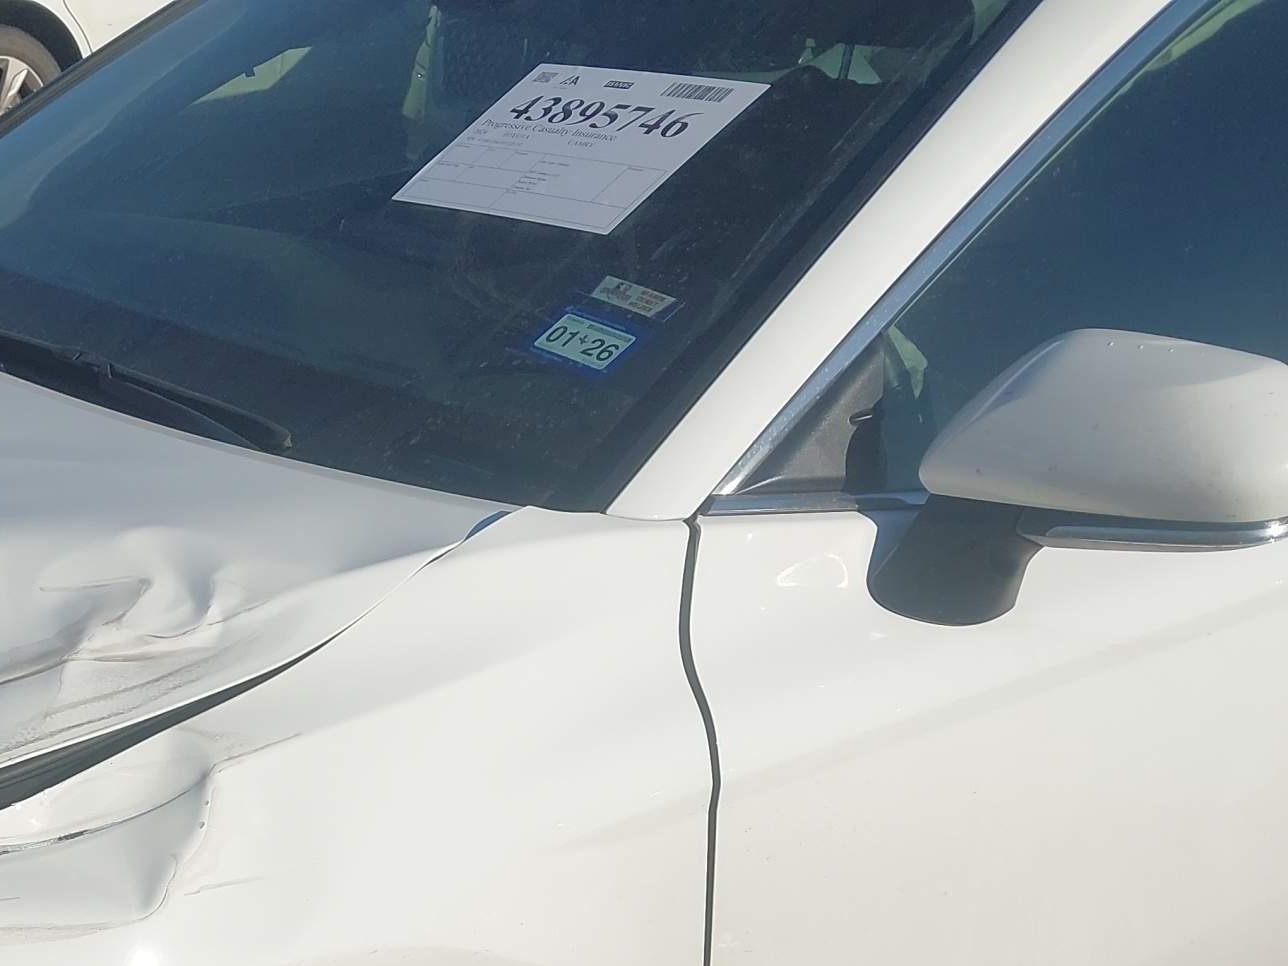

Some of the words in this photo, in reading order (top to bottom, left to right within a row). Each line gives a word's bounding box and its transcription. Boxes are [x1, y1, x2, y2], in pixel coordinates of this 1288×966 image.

[481, 119, 532, 131] Progressive
[532, 123, 569, 137] Casualty
[571, 127, 617, 142] Insurance
[510, 95, 704, 139] 43895746
